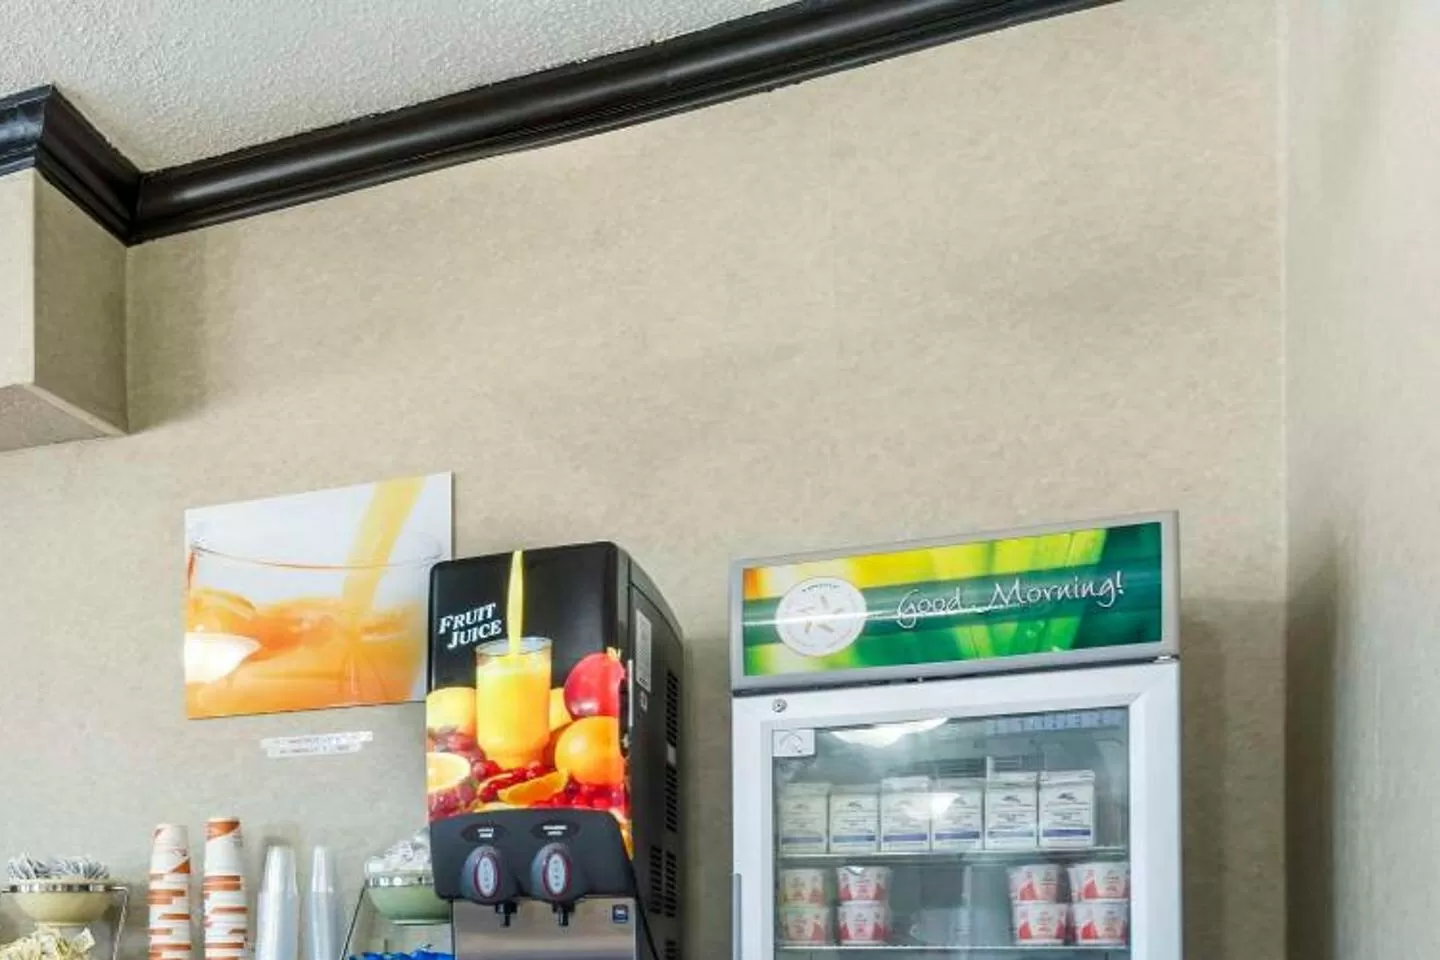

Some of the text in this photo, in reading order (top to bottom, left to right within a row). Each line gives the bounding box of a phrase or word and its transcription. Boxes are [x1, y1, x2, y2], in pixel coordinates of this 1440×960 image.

[896, 570, 1125, 629] Good Morning!
[438, 602, 497, 635] FRUIT
[446, 619, 502, 650] JUICE
